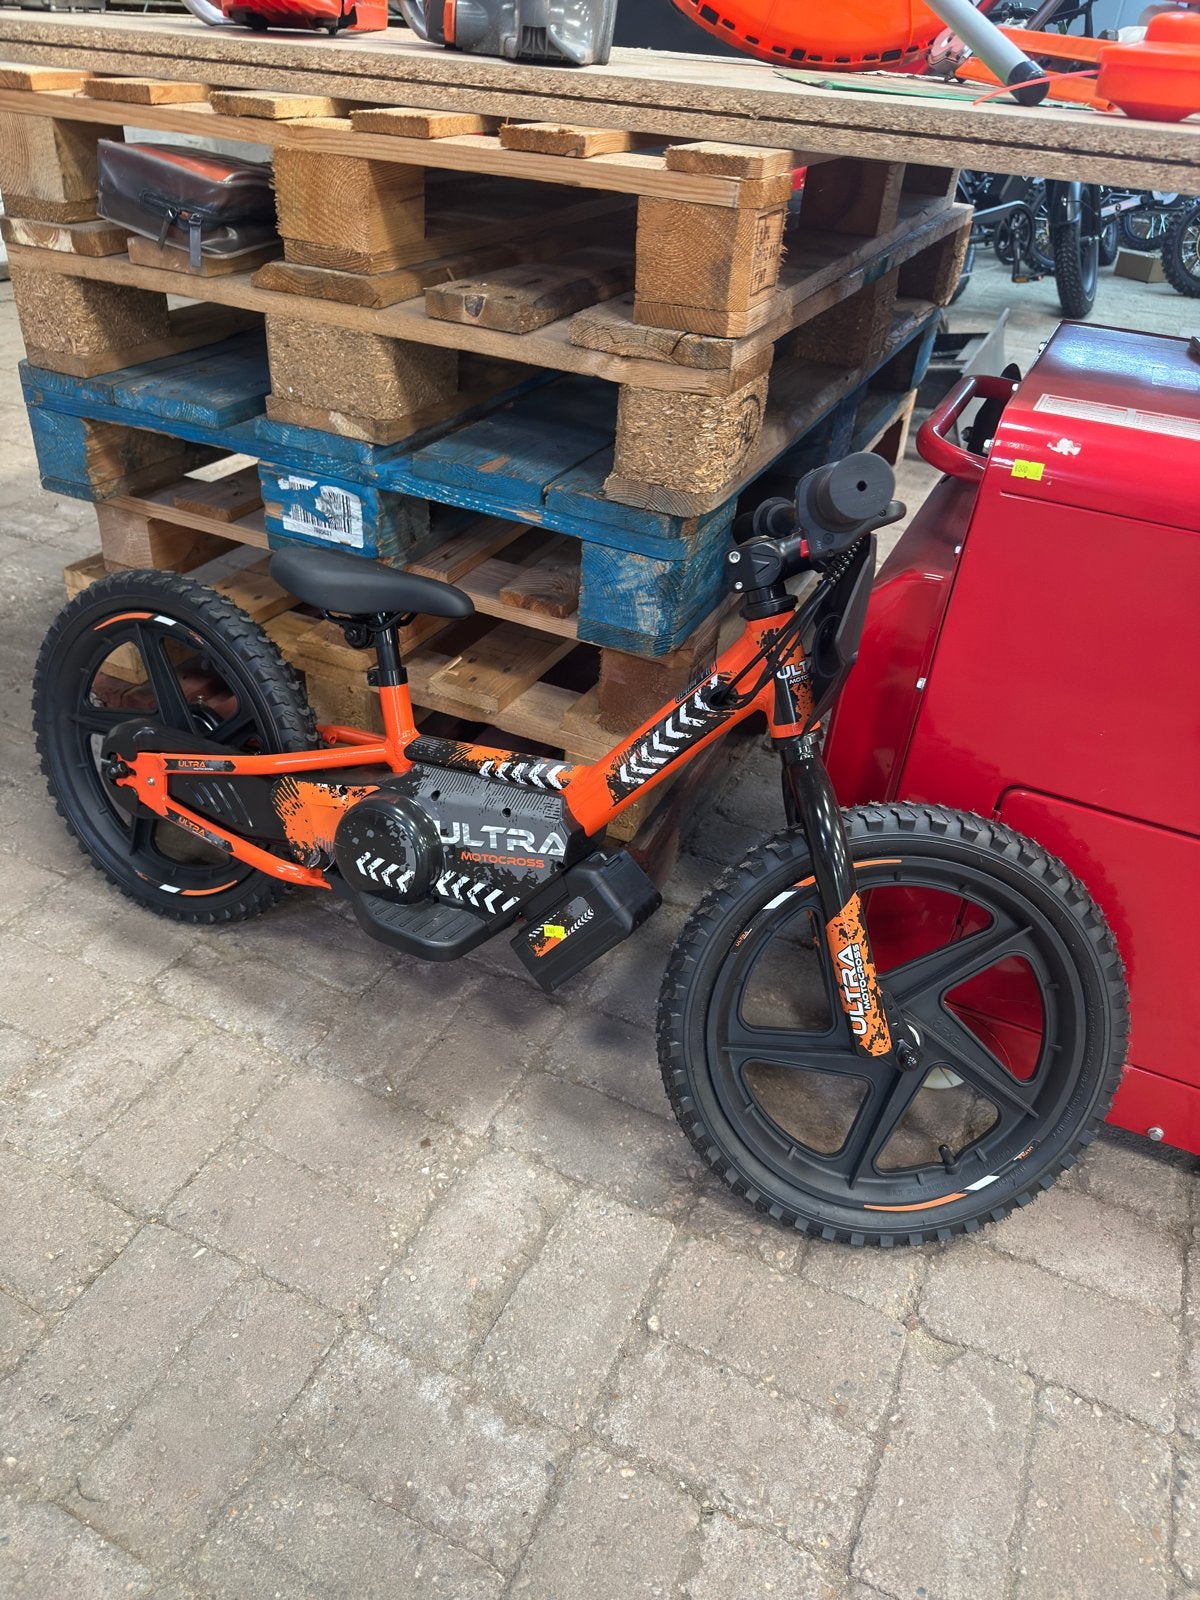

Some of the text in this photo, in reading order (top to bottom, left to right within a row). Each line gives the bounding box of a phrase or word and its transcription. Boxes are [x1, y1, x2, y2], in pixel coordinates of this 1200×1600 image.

[776, 660, 806, 680] ULT
[178, 760, 206, 768] ULTRA
[178, 816, 205, 836] ULTRA
[434, 819, 566, 857] ULTRA
[460, 850, 545, 869] MOTOCROSS
[853, 943, 872, 1011] MOTOCROSS
[838, 944, 867, 1036] ULTRA
